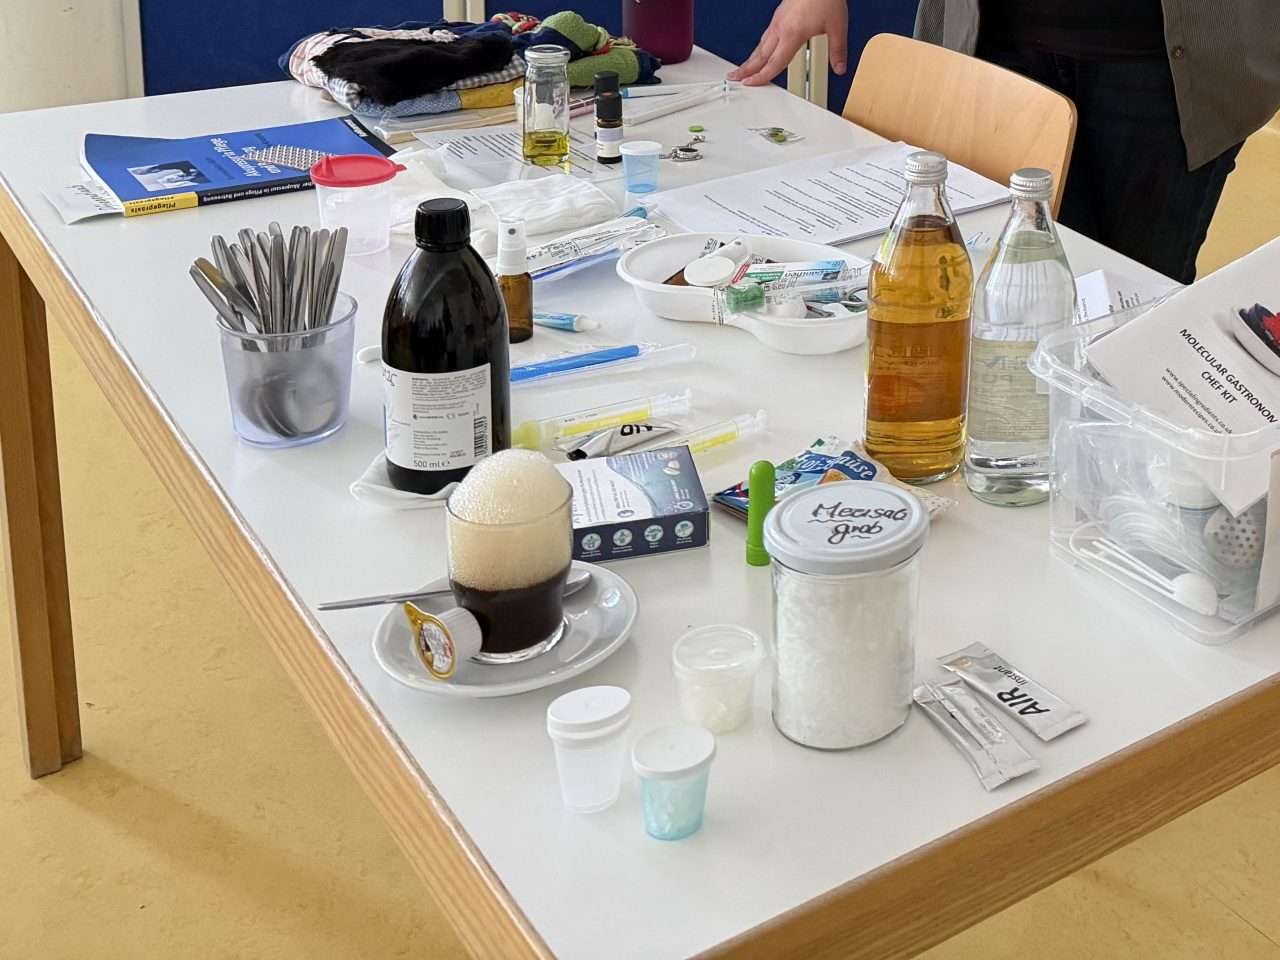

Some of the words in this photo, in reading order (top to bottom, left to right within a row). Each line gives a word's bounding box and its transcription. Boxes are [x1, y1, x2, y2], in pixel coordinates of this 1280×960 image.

[1180, 328, 1228, 376] MOLECULAR
[1201, 371, 1224, 393] CHEF
[1220, 389, 1238, 404] KIT
[828, 521, 883, 544] grob
[993, 665, 1029, 686] instant
[997, 687, 1051, 716] AIR
